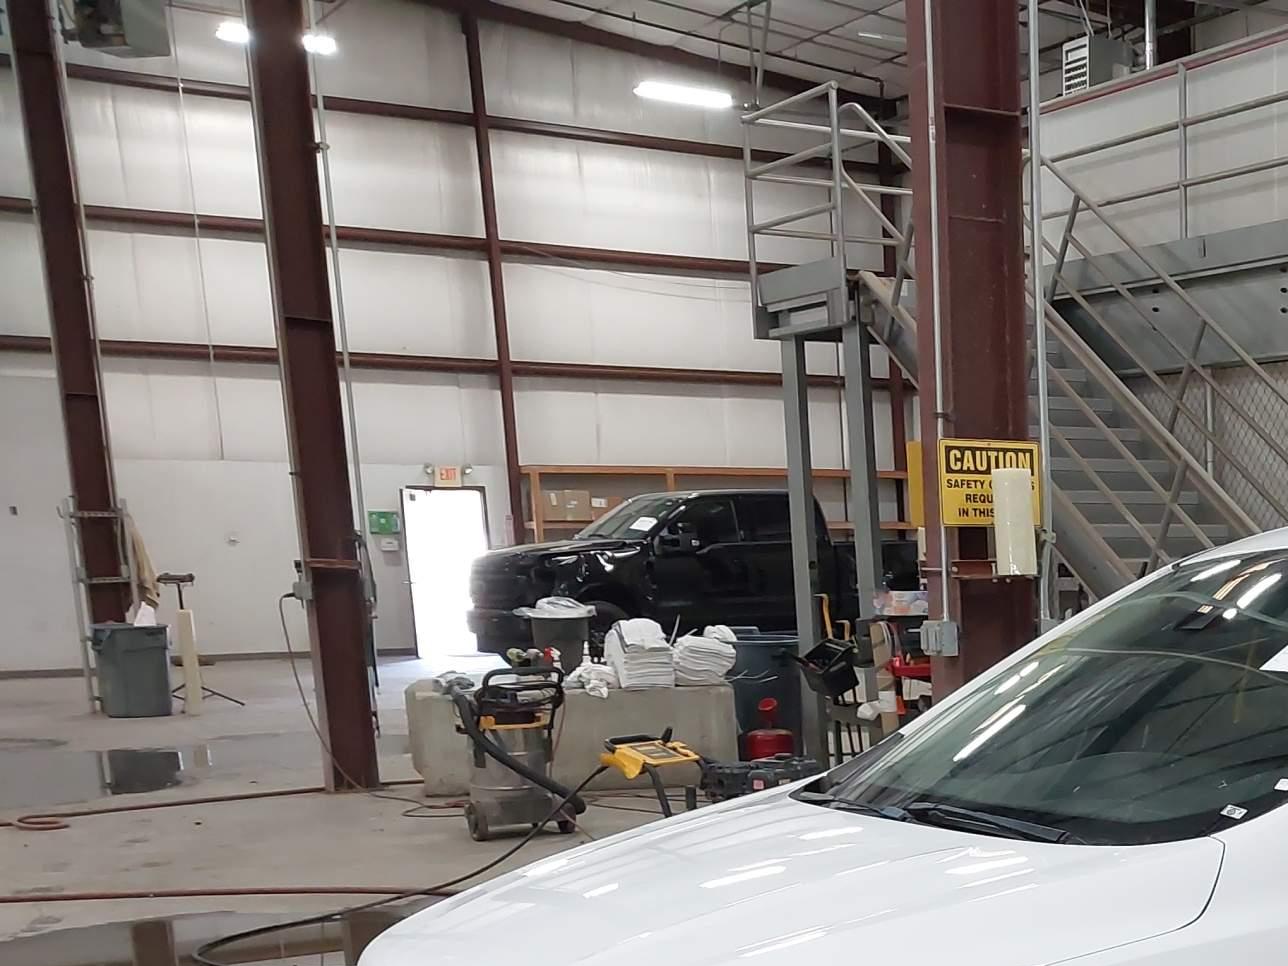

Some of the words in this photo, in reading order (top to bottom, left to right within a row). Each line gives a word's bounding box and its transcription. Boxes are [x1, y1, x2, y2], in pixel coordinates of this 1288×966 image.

[949, 449, 1031, 471] CAUTION
[440, 468, 457, 480] EXIT
[946, 479, 985, 490] SAFETY
[965, 493, 994, 504] REQU
[958, 508, 969, 518] IN
[972, 508, 995, 518] THIS
